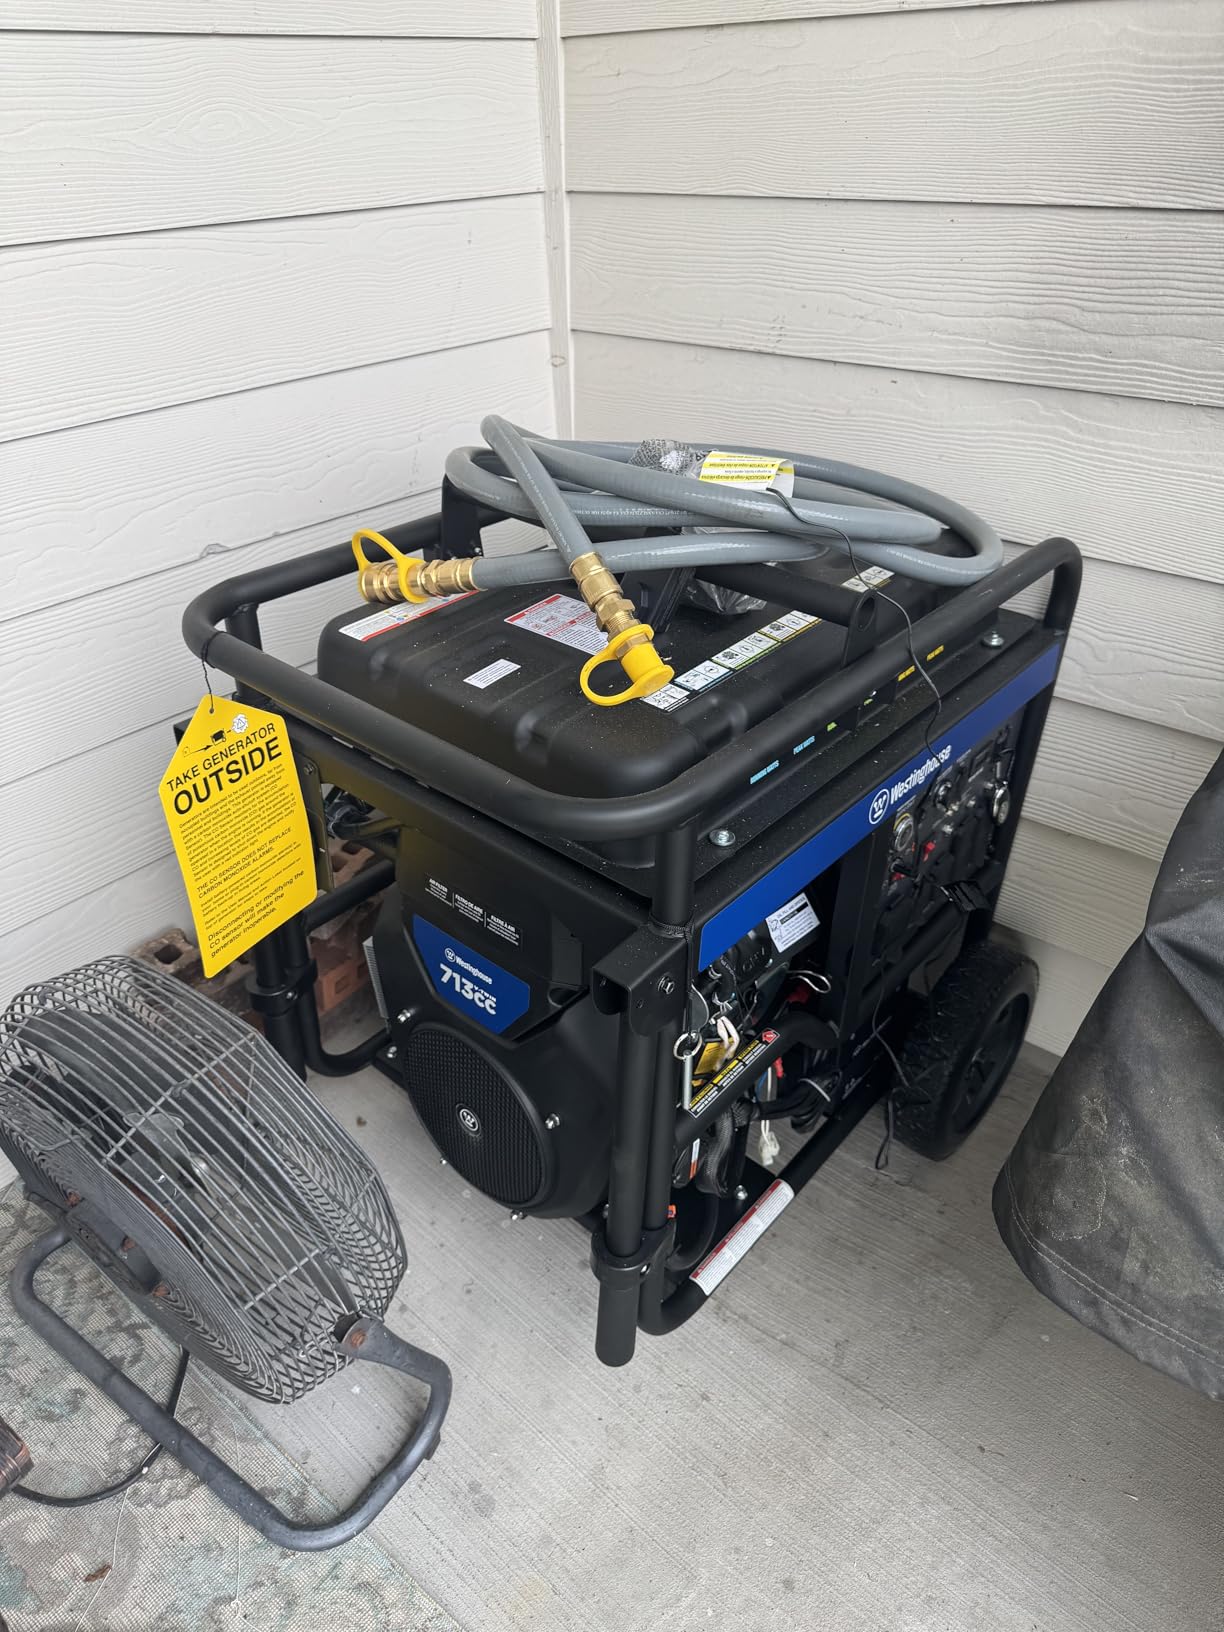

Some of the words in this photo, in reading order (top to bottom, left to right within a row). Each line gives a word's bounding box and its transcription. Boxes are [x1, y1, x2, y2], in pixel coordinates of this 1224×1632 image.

[167, 764, 200, 791] TAKE
[202, 723, 276, 771] GENERATOR
[174, 736, 282, 815] OUTSIDE
[197, 881, 208, 892] THE
[208, 904, 254, 942] Disconnecting
[263, 877, 293, 903] modifying
[294, 869, 304, 880] the
[209, 937, 220, 949] CO
[221, 922, 243, 940] sensor
[244, 912, 255, 923] will
[256, 899, 273, 914] make
[274, 891, 284, 902] the
[455, 955, 493, 985] Westinghouse
